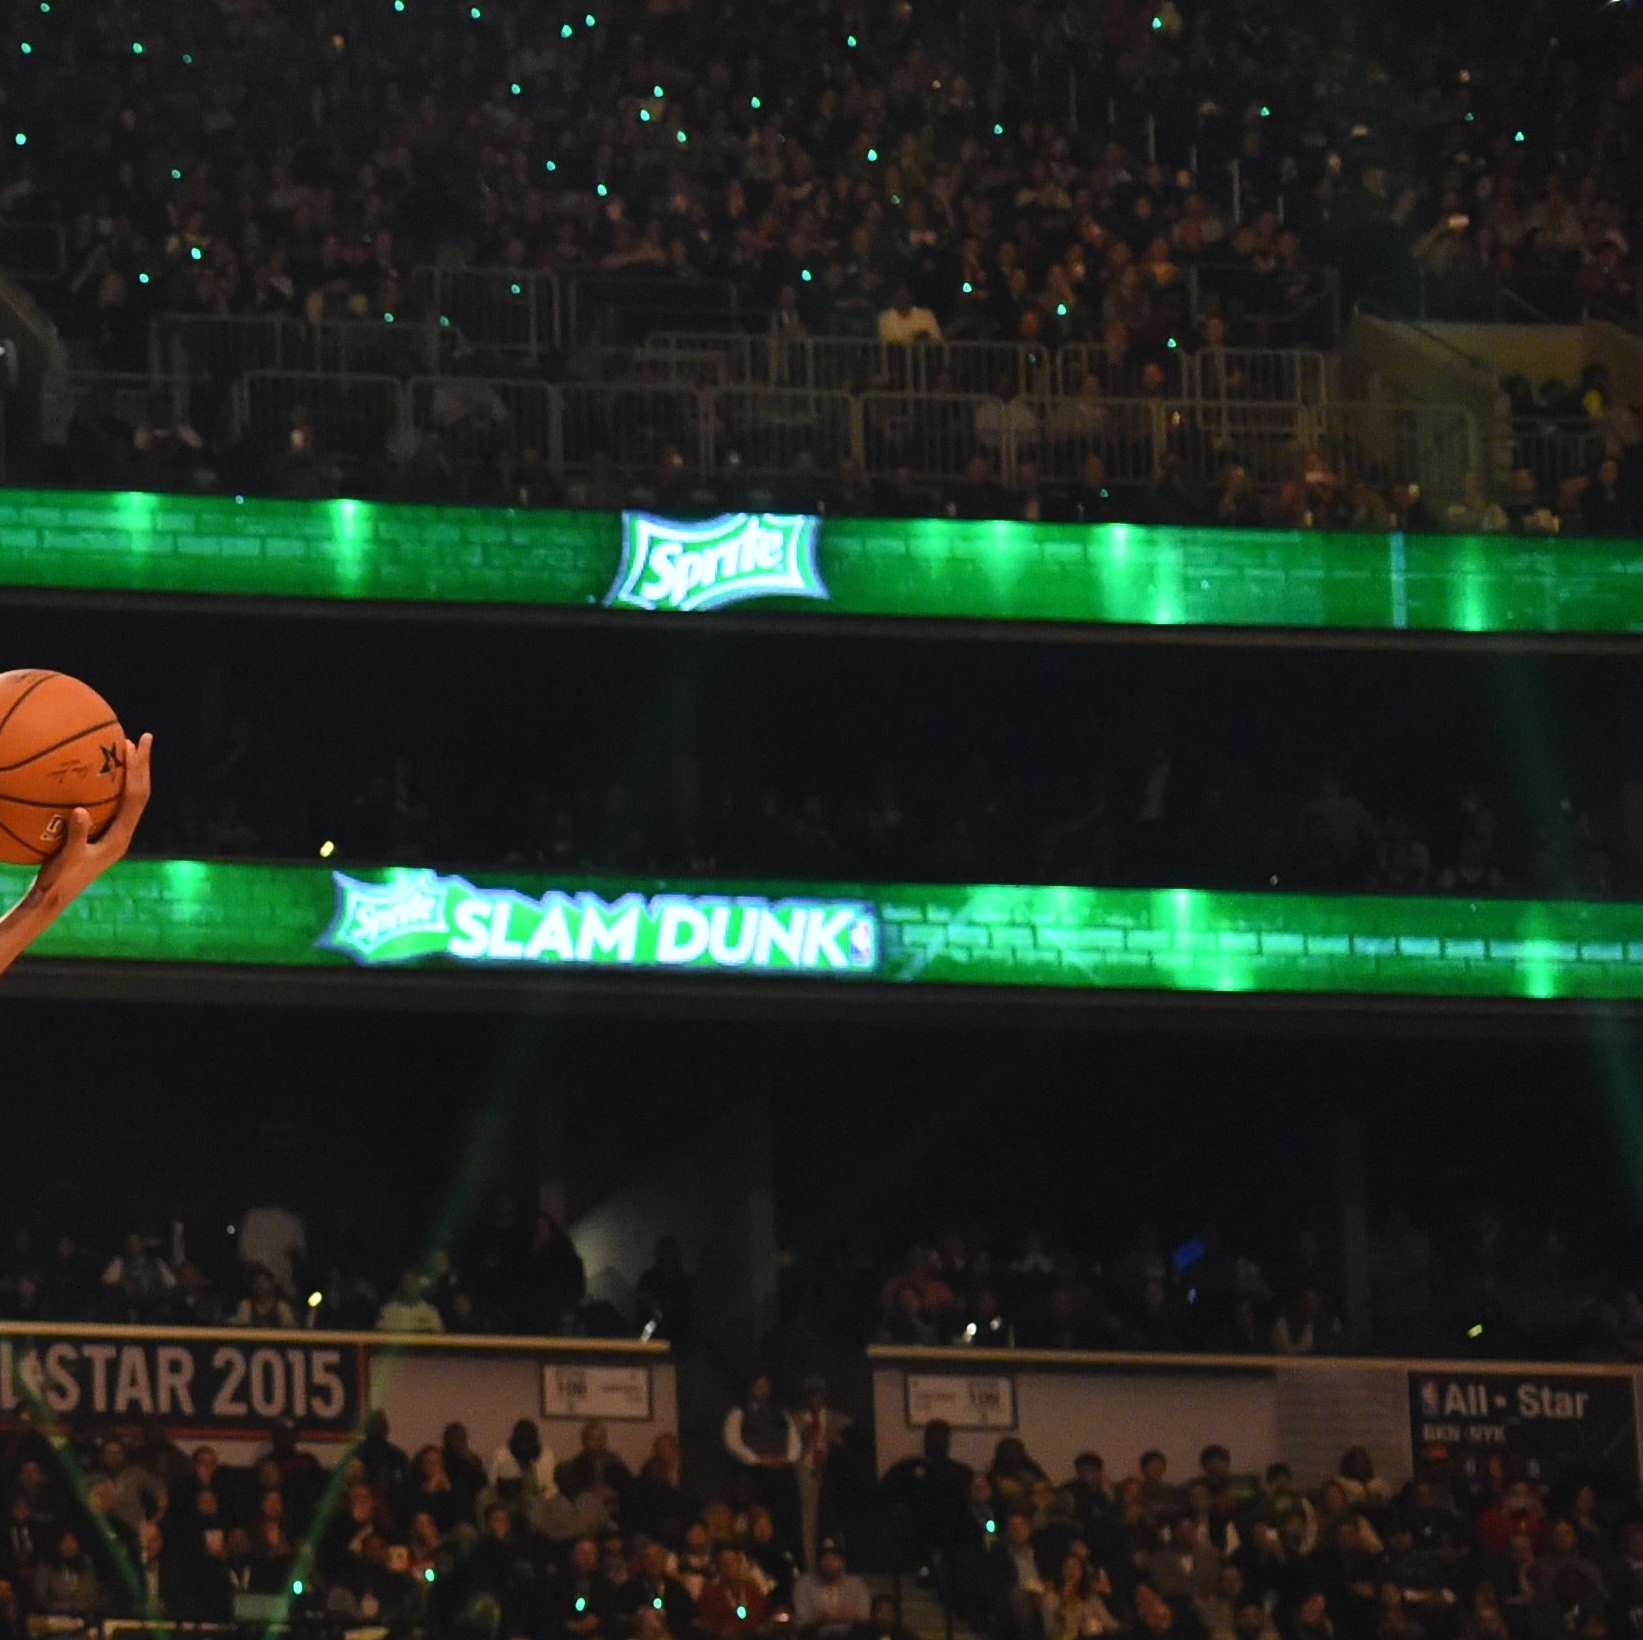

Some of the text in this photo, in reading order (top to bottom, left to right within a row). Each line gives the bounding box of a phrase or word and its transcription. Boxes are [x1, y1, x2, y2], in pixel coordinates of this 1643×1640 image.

[641, 516, 784, 606] Sprite
[447, 901, 637, 961] SLAM
[656, 904, 849, 967] DUNK
[213, 1348, 345, 1420] 2015
